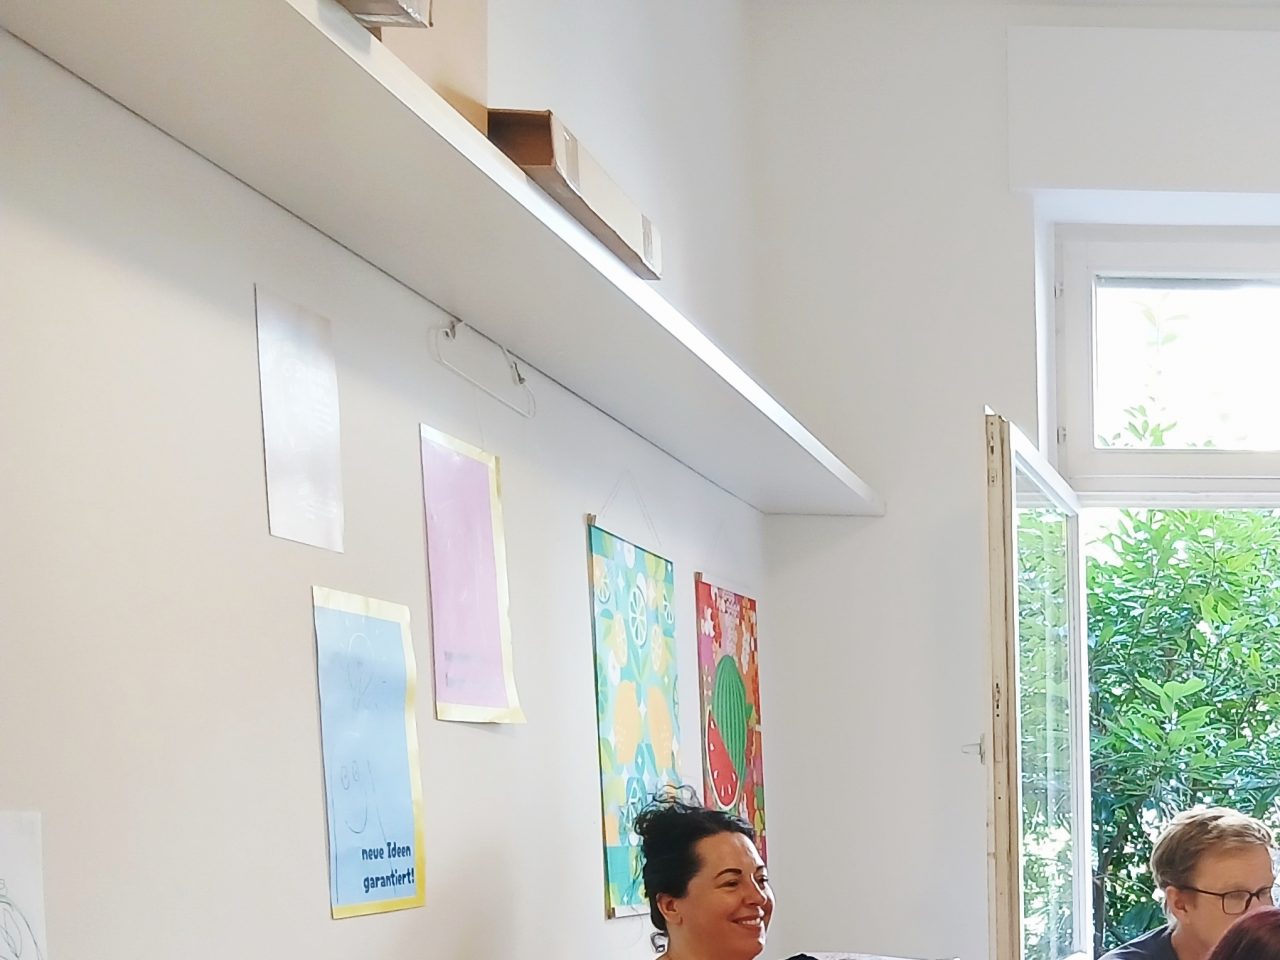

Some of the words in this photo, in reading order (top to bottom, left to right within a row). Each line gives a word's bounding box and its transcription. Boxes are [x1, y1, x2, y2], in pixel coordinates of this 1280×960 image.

[361, 847, 384, 861] neue
[386, 841, 411, 859] Ideen
[363, 867, 415, 894] garantiert!
